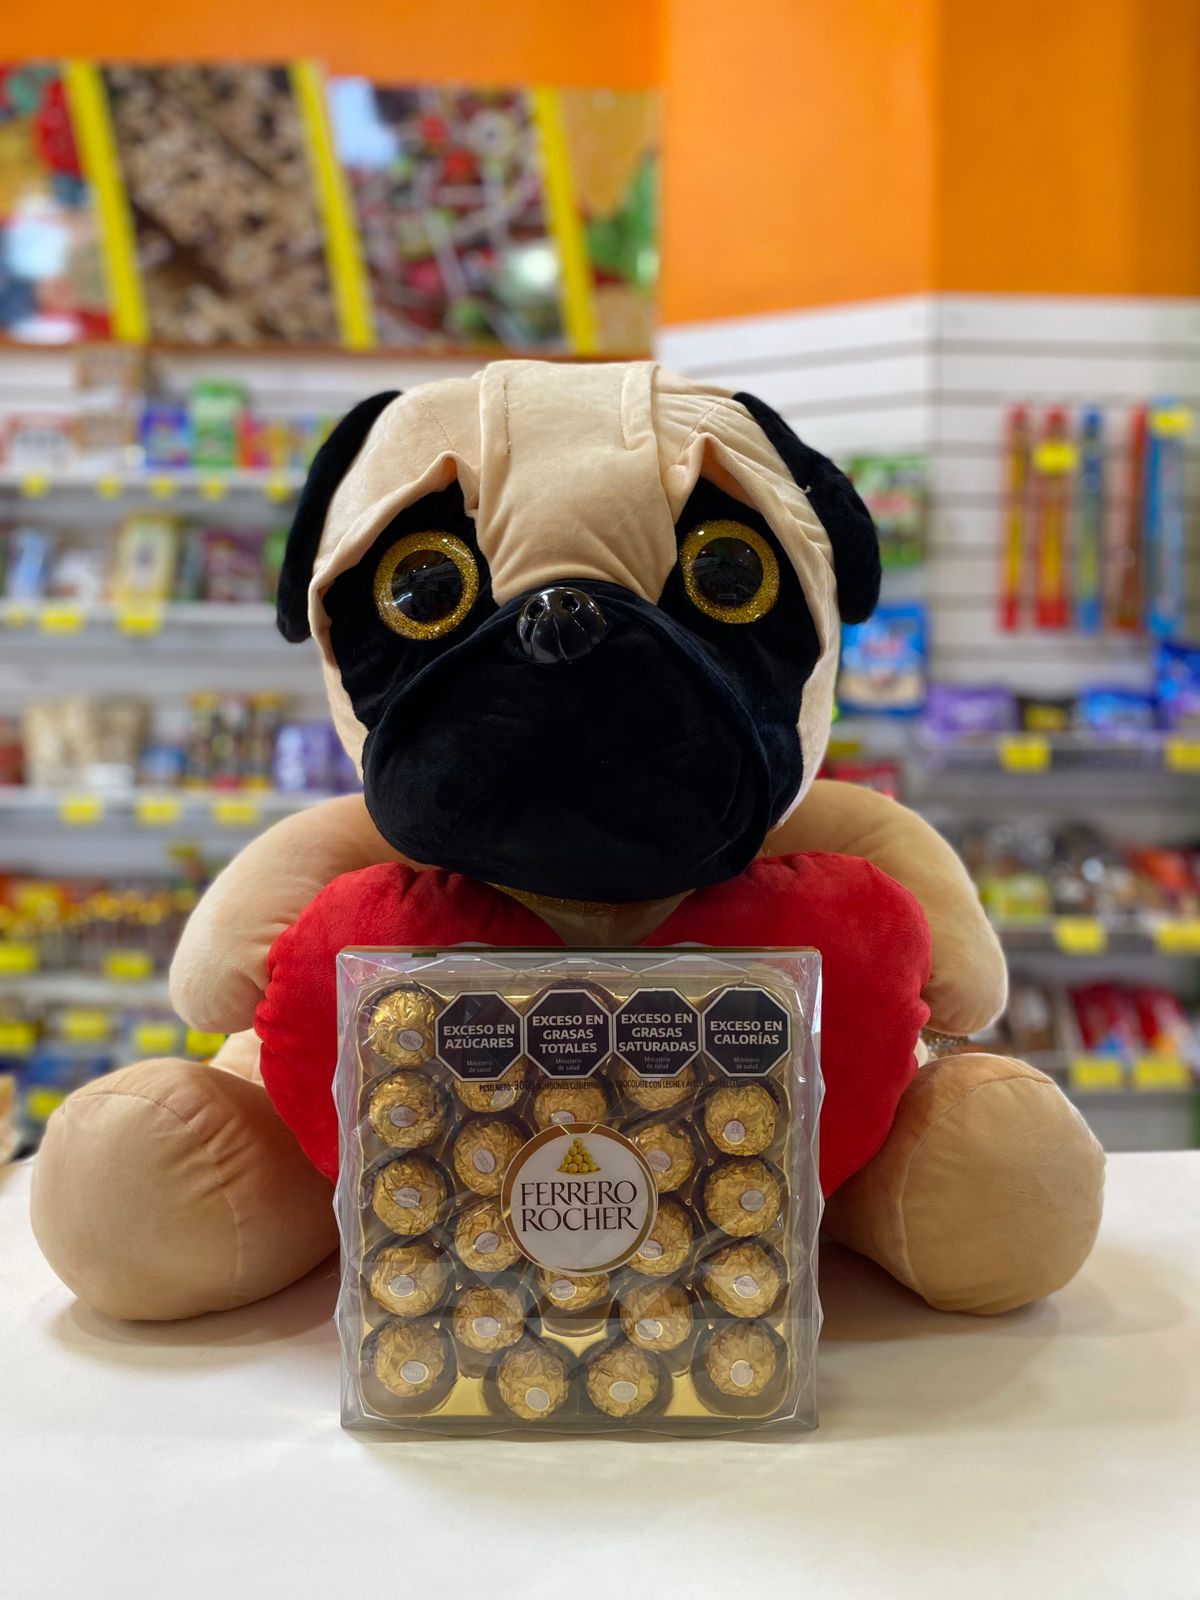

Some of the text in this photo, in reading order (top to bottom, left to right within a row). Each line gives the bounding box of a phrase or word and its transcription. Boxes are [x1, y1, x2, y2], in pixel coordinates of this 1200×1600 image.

[532, 1014, 604, 1026] EXCESO EN
[621, 1013, 693, 1024] EXCESO EN
[443, 1024, 515, 1036] EXCESO EN
[710, 1020, 783, 1031] EXCESO EN
[543, 1029, 594, 1040] GRASAS
[631, 1027, 683, 1038] GRASAS
[445, 1036, 514, 1049] AZÚCARES
[714, 1032, 780, 1045] CALORÍAS
[539, 1043, 597, 1054] TOTALES
[618, 1041, 697, 1052] SATURADAS
[520, 1180, 638, 1206] FERRERO
[521, 1206, 639, 1232] ROCHER
